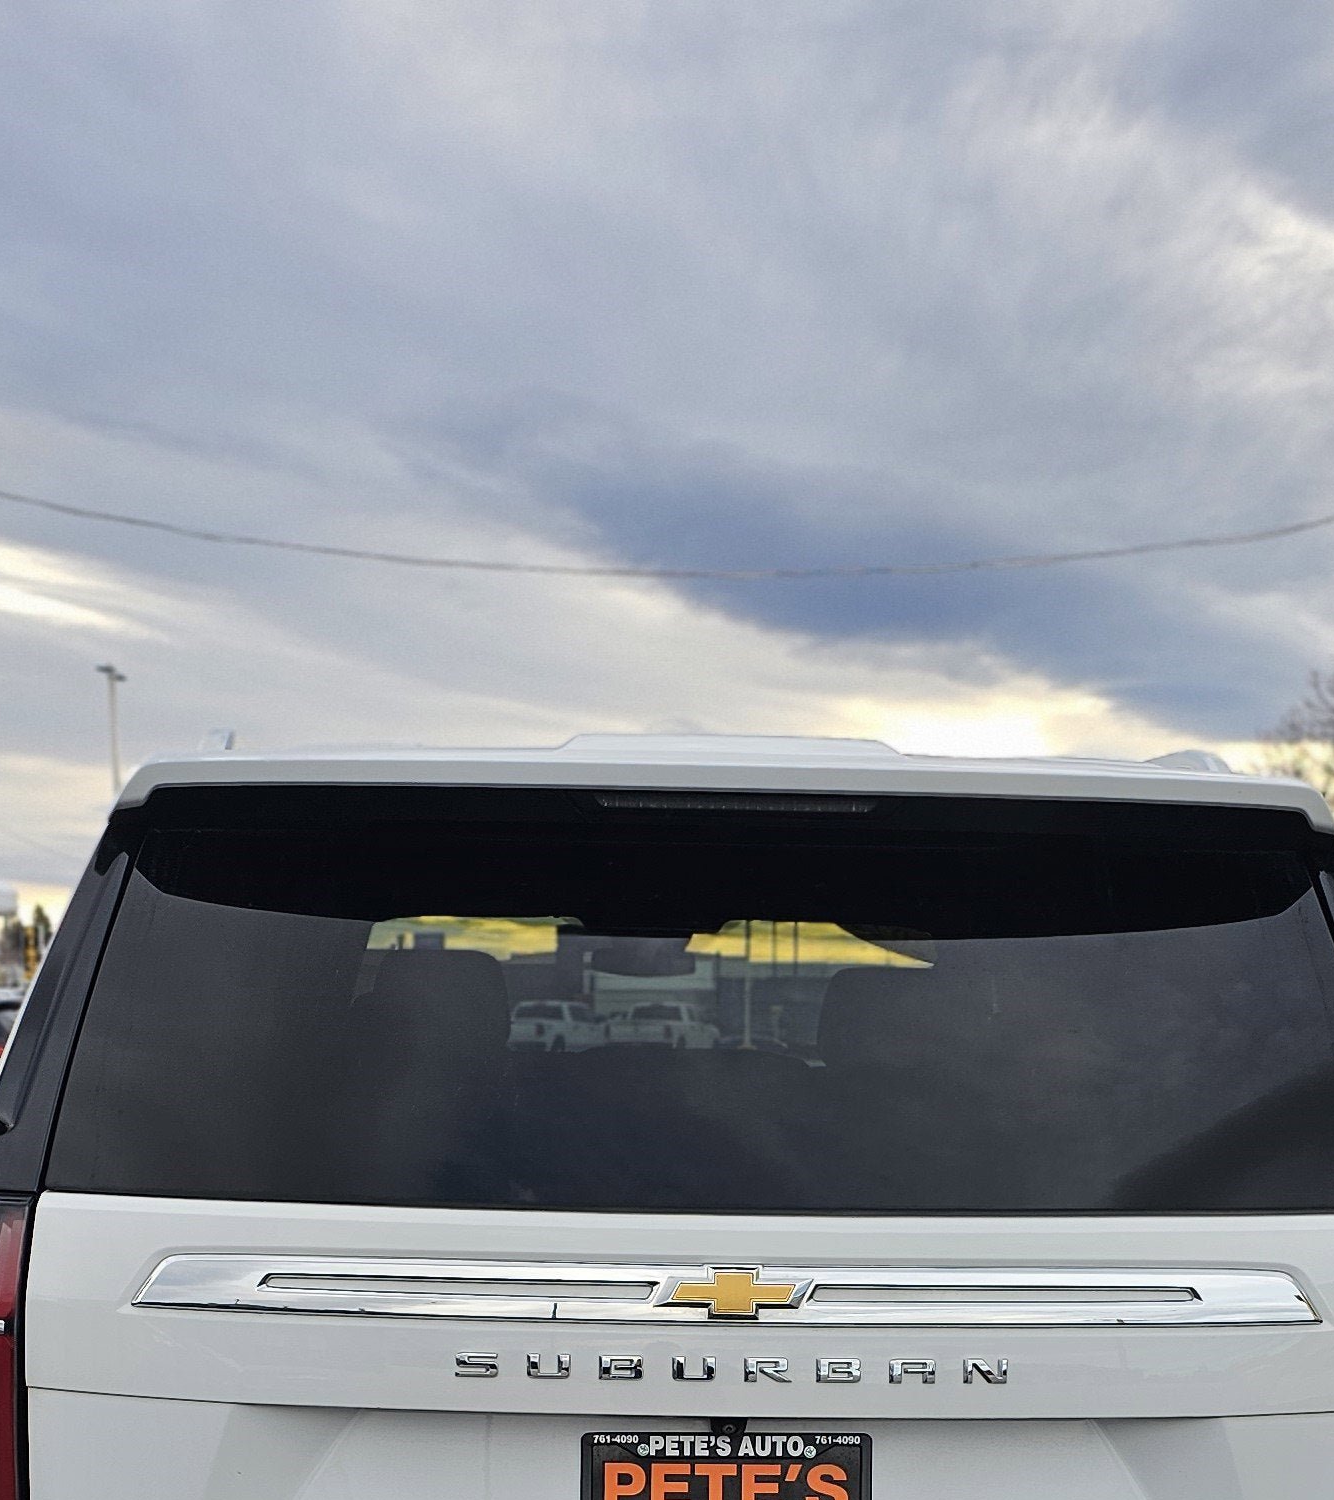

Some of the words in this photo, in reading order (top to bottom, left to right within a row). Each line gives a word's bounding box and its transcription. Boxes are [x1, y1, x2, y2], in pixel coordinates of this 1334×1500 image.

[454, 1350, 1009, 1385] SUBURBAN
[592, 1434, 639, 1445] 761-4090
[649, 1435, 732, 1457] PETE'S
[737, 1435, 805, 1458] AUTO
[814, 1435, 861, 1446] 761-4090
